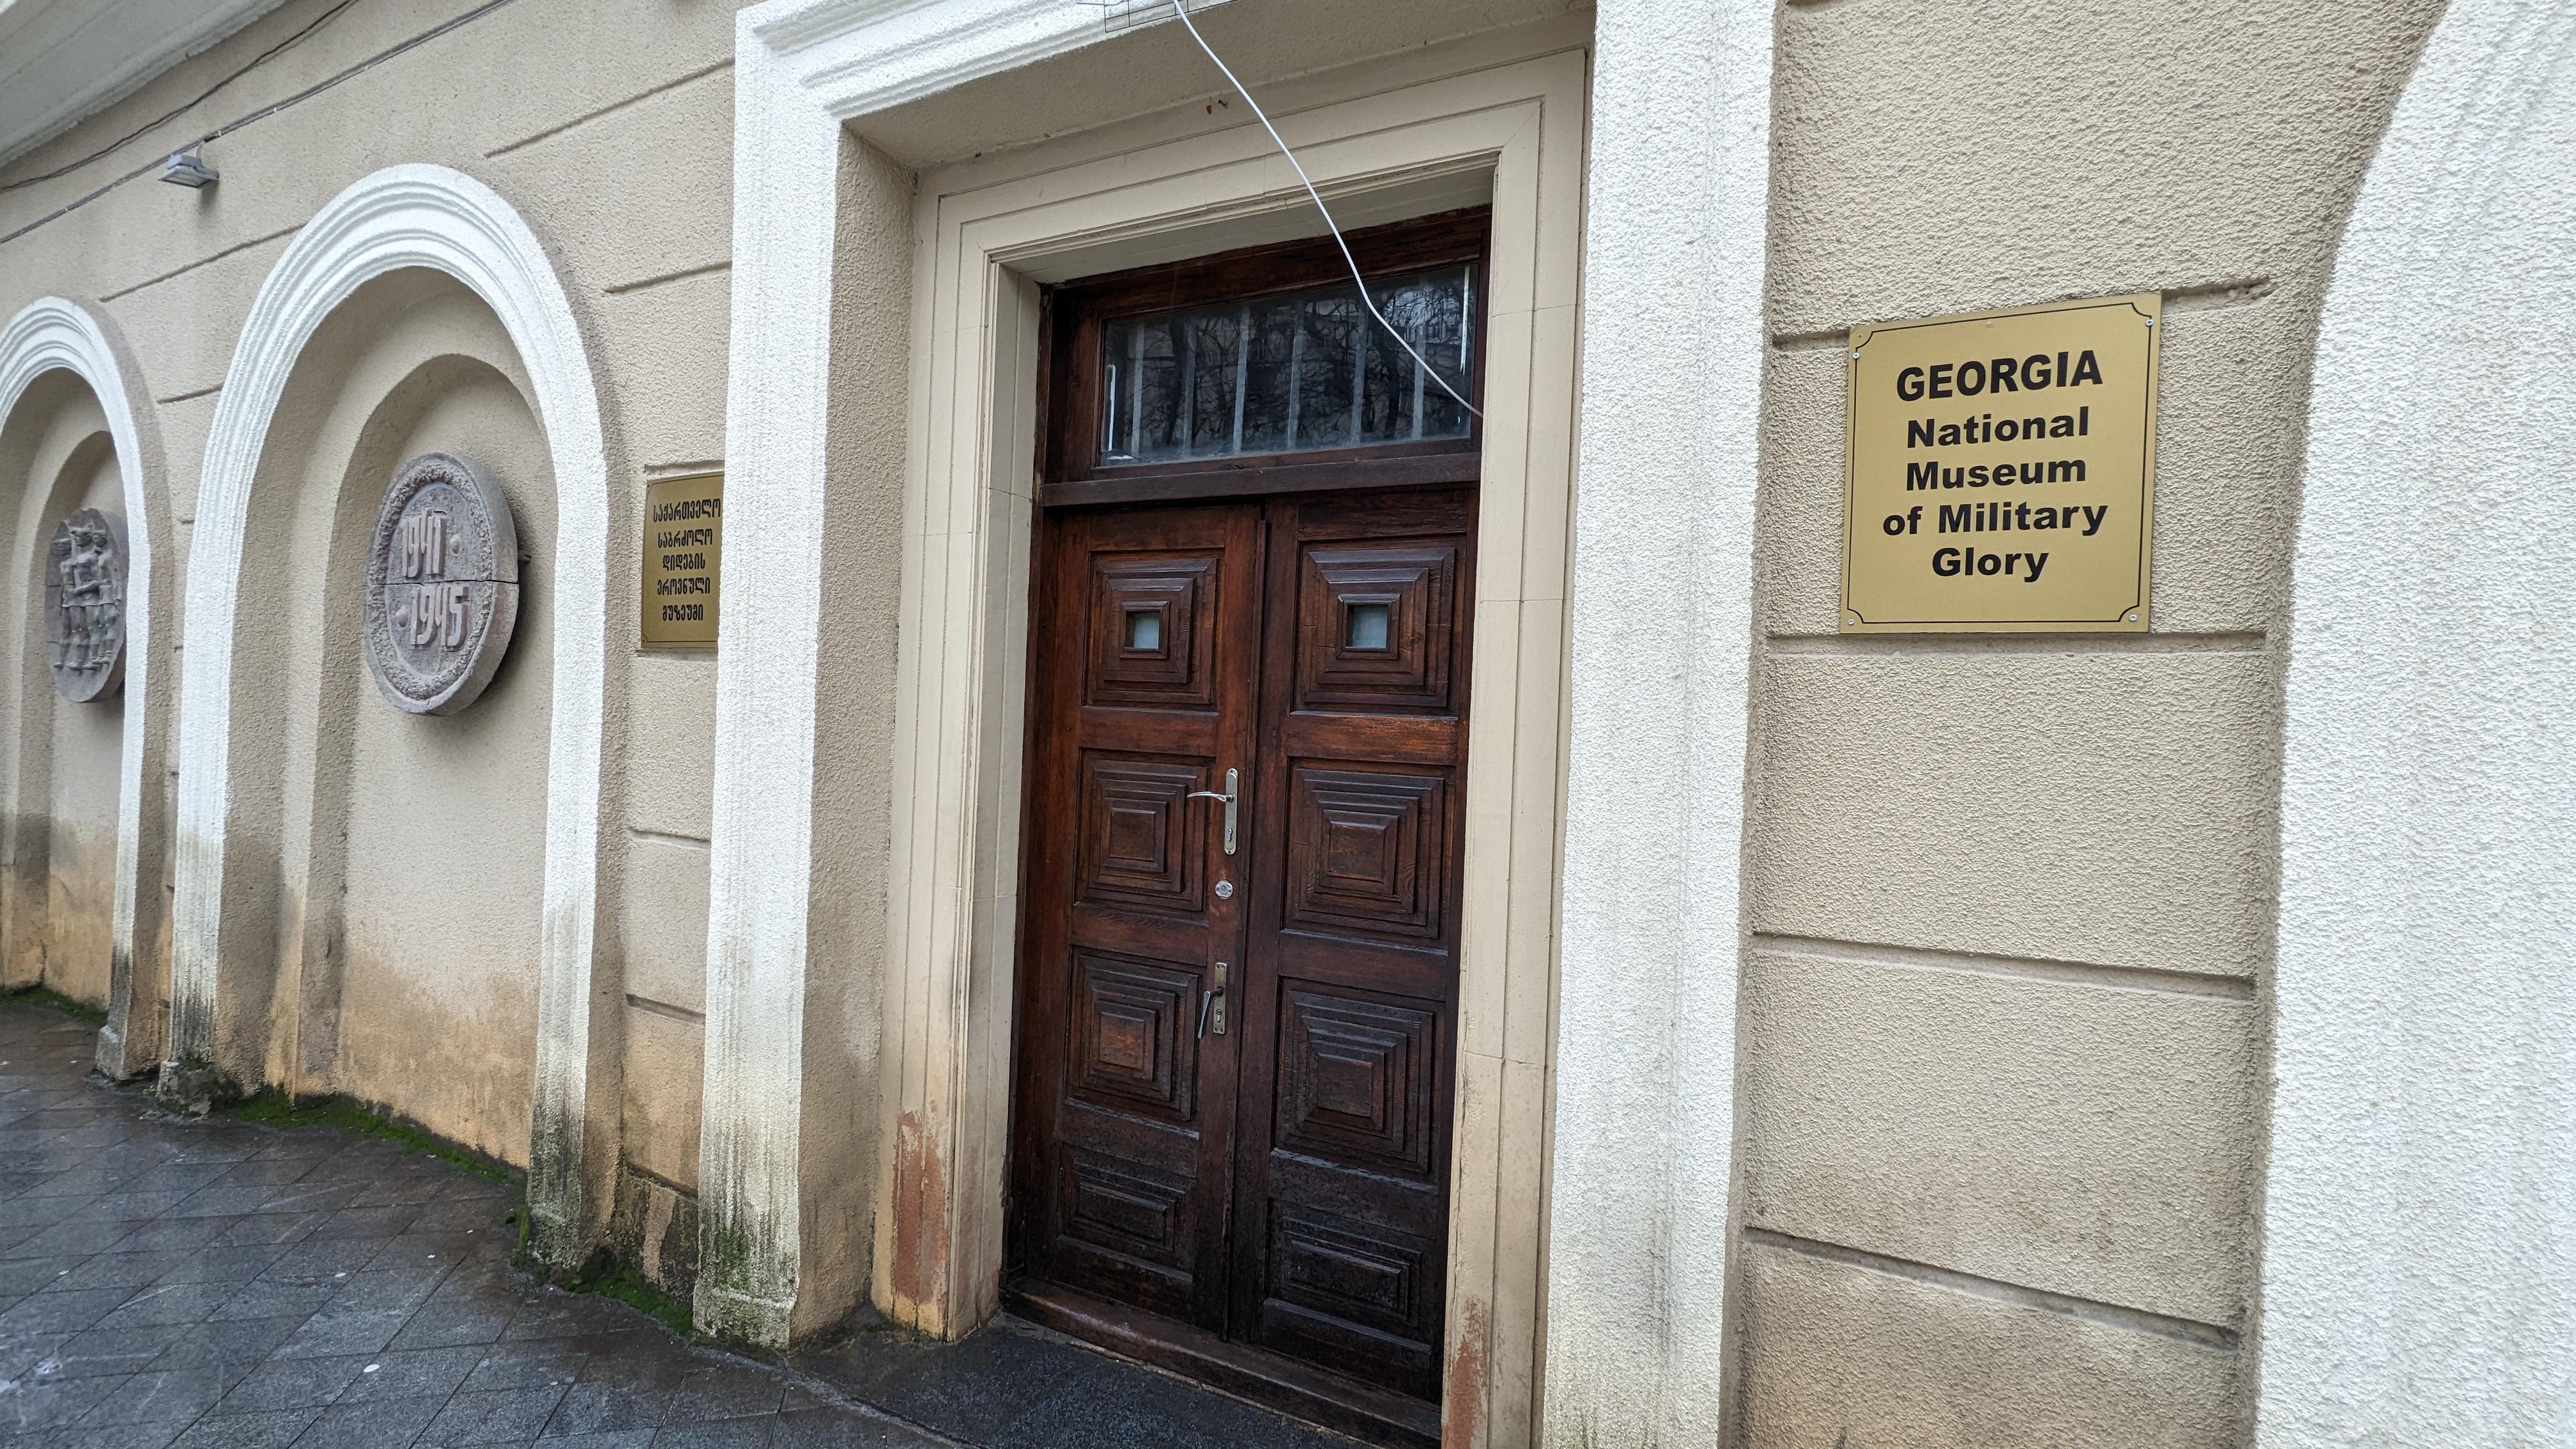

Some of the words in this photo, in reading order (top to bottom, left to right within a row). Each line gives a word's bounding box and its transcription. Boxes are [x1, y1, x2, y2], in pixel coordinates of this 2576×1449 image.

[1896, 349, 2103, 402] GEORGIA
[1906, 406, 2089, 448] National
[1906, 459, 2086, 491] Museum
[653, 498, 721, 523] საქართველო
[1882, 505, 1923, 536] of
[1938, 501, 2108, 537] Military
[657, 528, 713, 549] საბრძოლო
[662, 552, 706, 571] დიდების
[1931, 547, 2050, 583] Glory
[657, 577, 710, 595] ეროვნული
[410, 585, 468, 647] 1945
[663, 604, 703, 622] მუზეუმი
